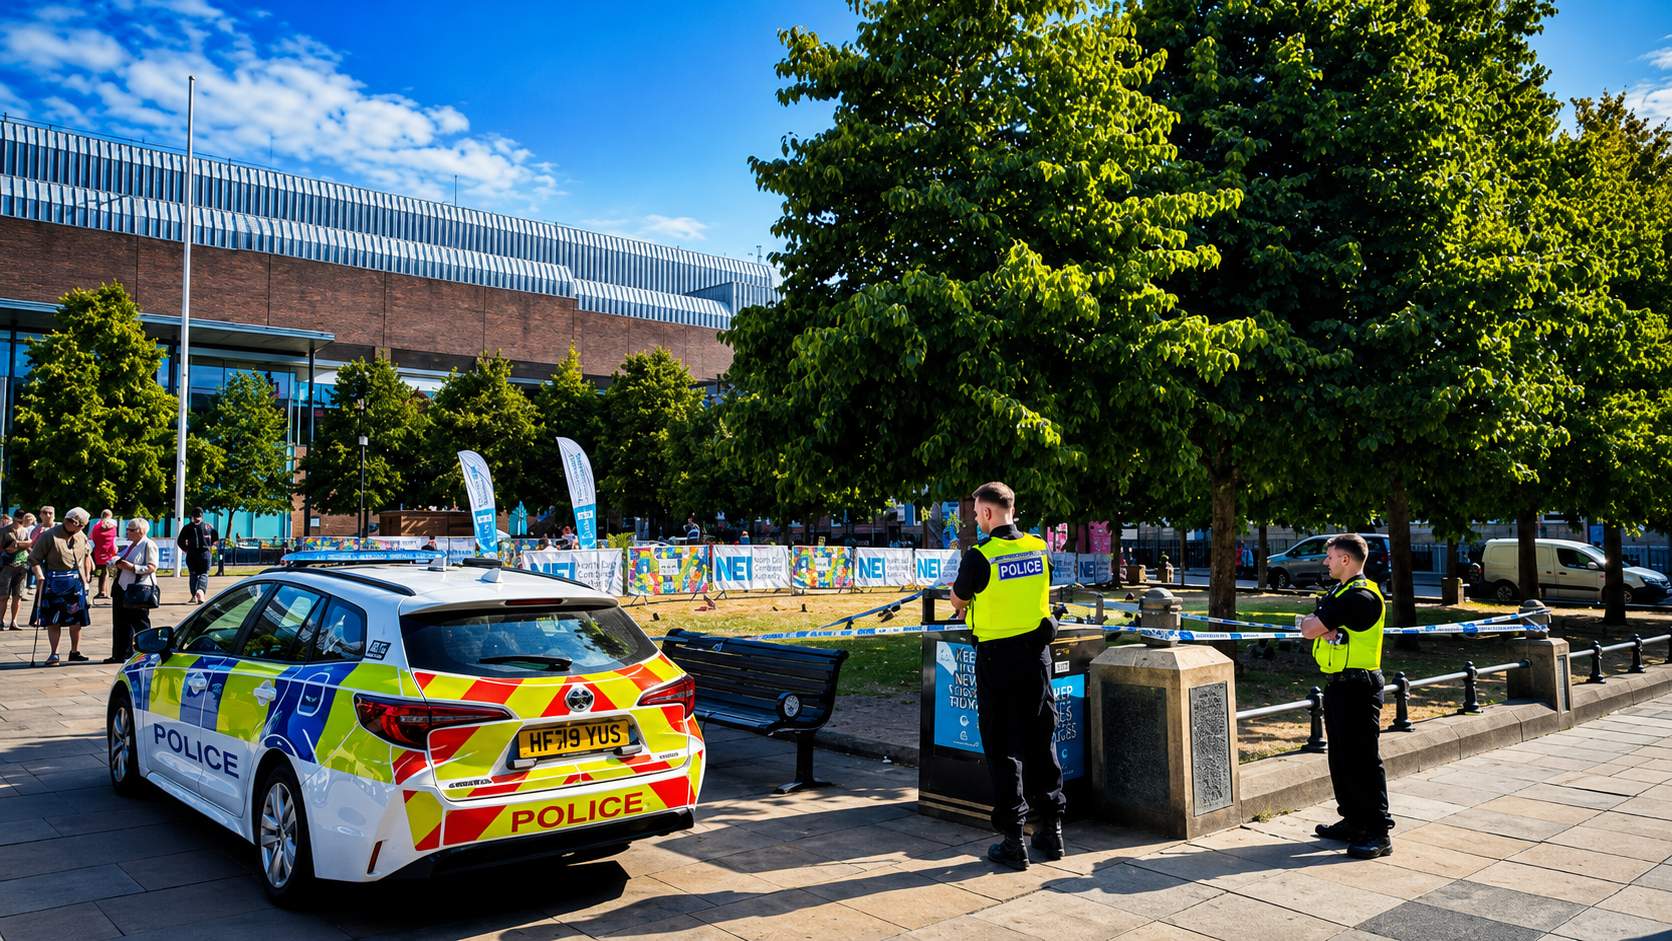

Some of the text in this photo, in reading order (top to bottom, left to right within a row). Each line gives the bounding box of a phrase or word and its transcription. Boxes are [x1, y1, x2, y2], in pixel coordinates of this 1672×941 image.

[1000, 560, 1042, 577] POLICE
[585, 724, 621, 746] YUS
[153, 723, 239, 779] POLICE
[511, 792, 643, 833] POLICE
